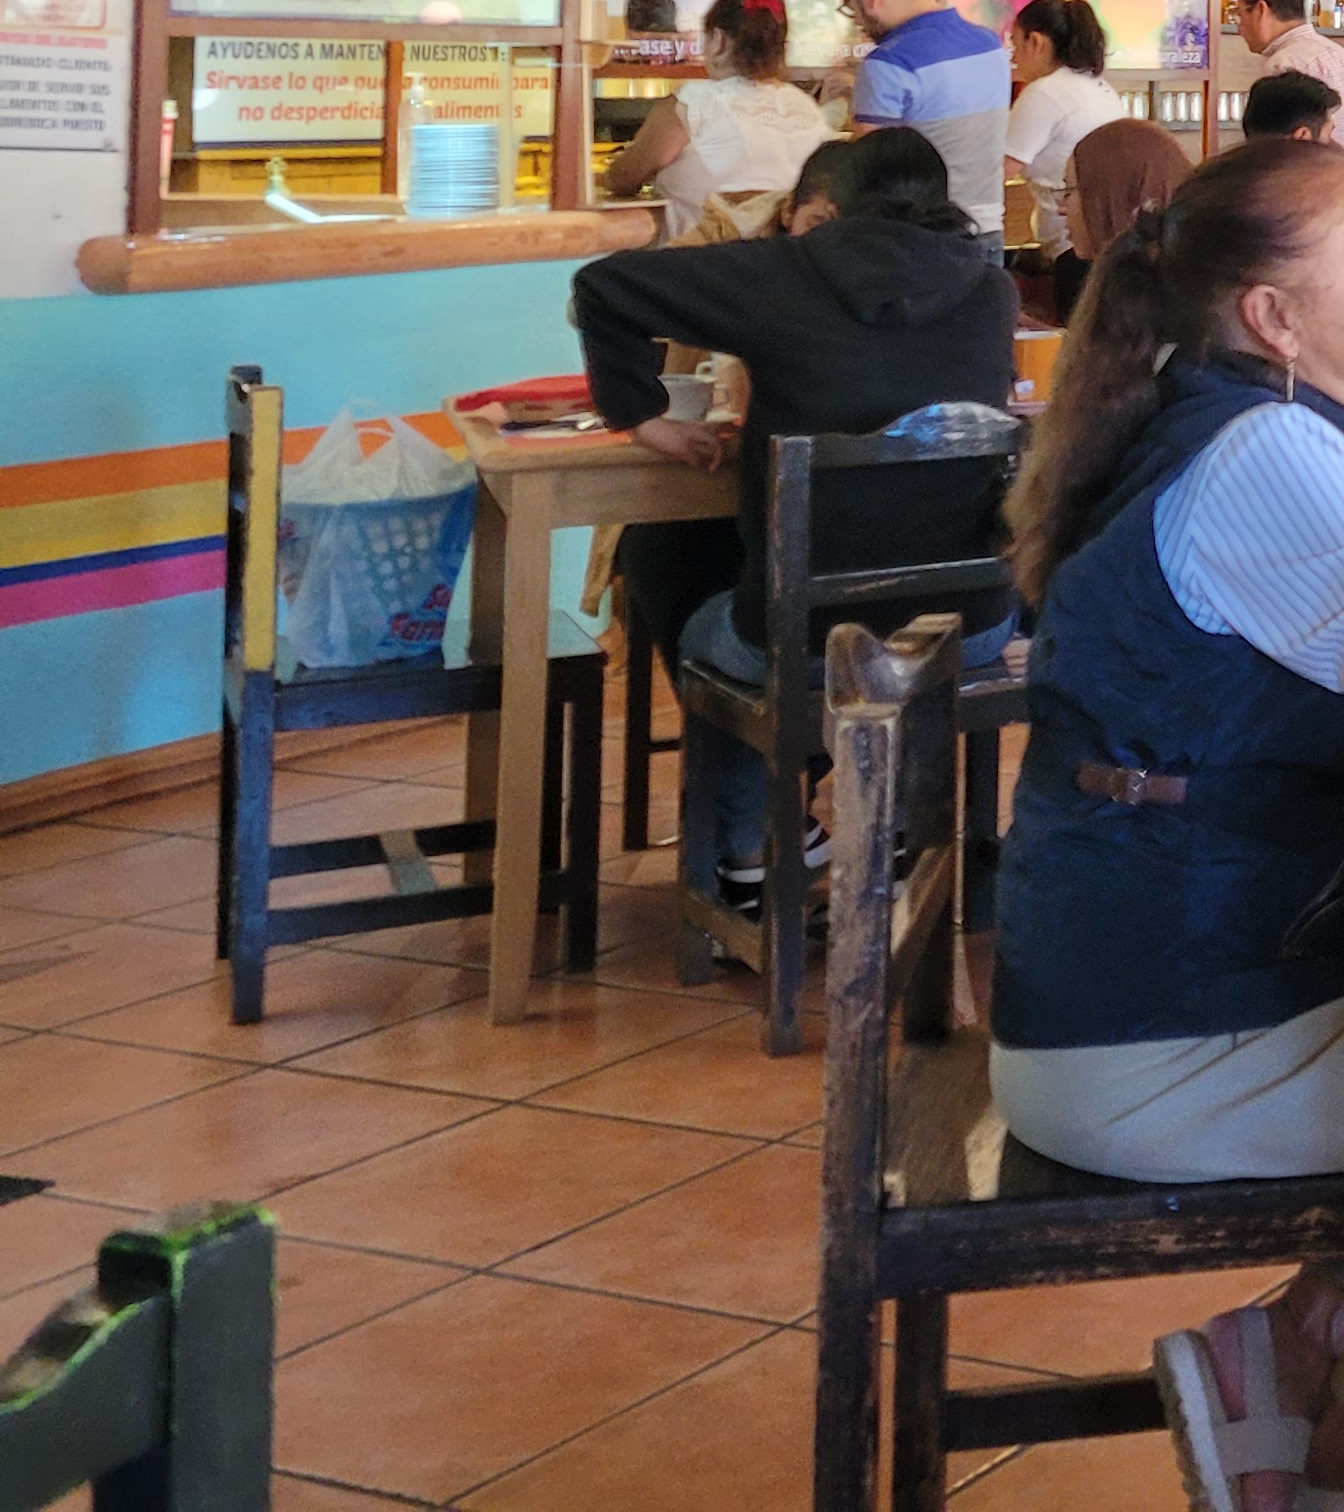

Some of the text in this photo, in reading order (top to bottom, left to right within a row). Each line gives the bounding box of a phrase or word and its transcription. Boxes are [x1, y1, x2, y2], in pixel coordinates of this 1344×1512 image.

[207, 41, 299, 60] AYUDENOS
[303, 42, 315, 60] A
[320, 43, 405, 62] MANTEN
[410, 44, 487, 62] NUESTROS
[287, 71, 307, 90] lo
[313, 75, 349, 96] que
[237, 101, 523, 123] no desperdicia aliments
